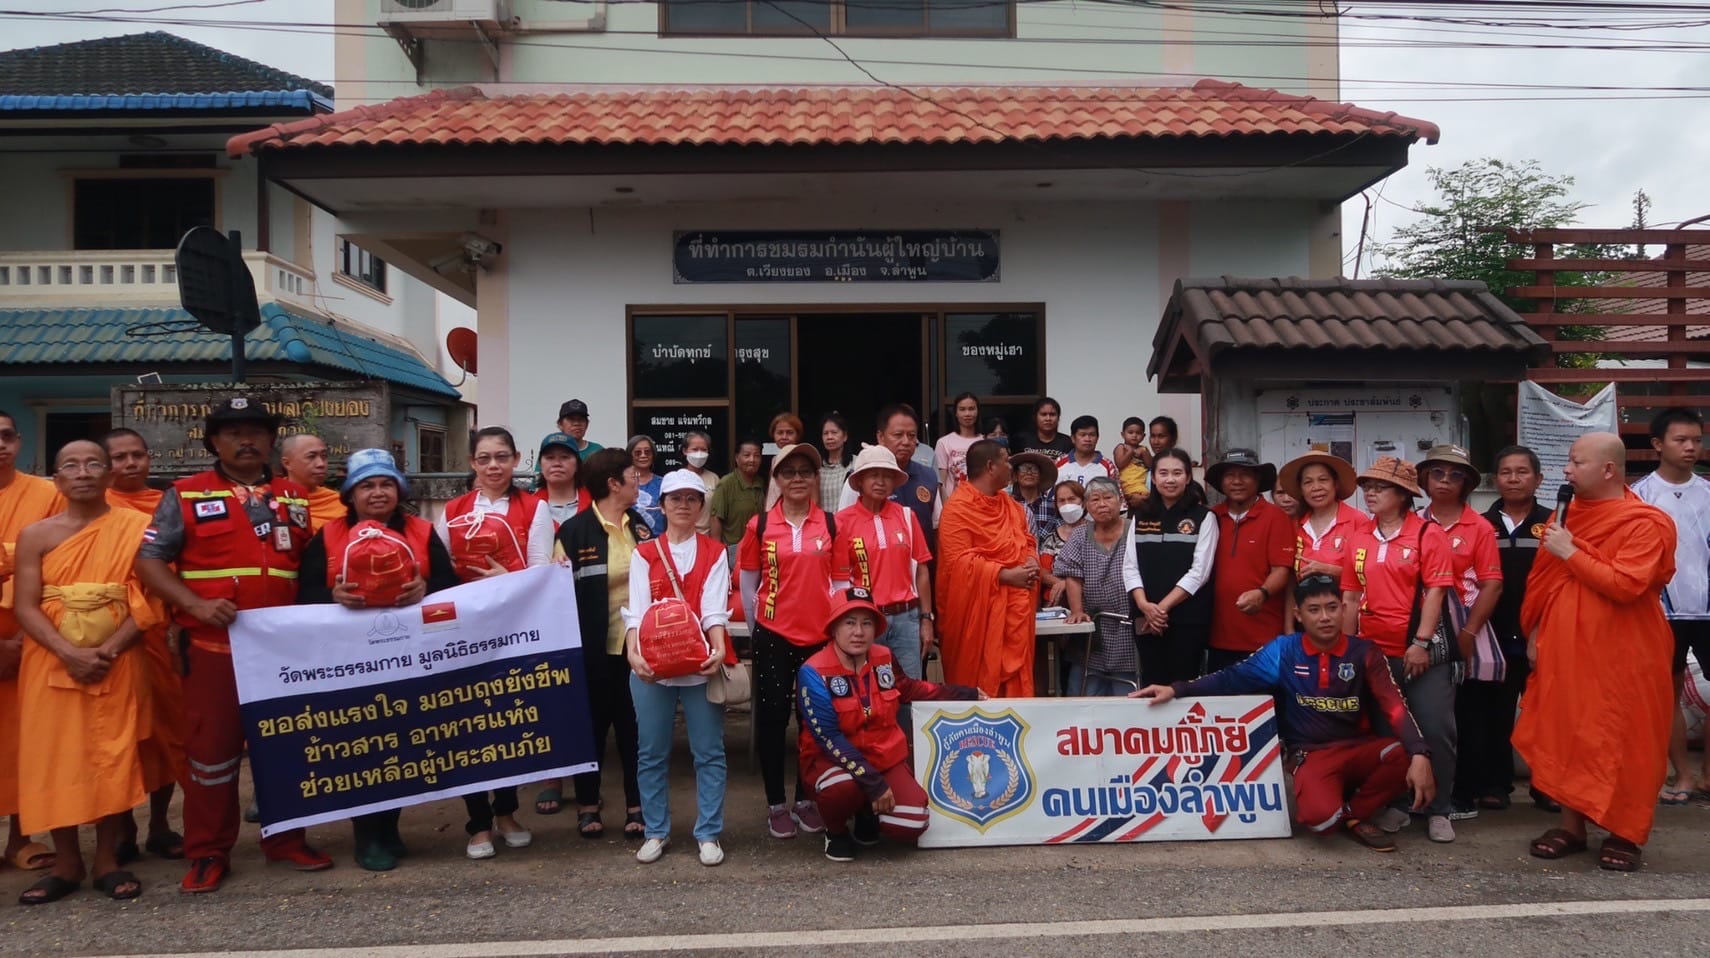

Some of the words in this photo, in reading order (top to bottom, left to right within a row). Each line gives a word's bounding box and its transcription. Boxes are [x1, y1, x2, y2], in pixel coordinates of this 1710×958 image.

[688, 233, 985, 264] ที่ทำการชมรมกำนันผู้ใหญ่บ้าน
[746, 263, 812, 277] ต.เวียงยอง
[824, 263, 867, 277] อ.เมือง
[879, 262, 928, 279] จ.ลำพูน
[652, 344, 712, 364] บำบัดทุกข์
[962, 343, 1023, 360] ของหมู่เฮา
[764, 541, 779, 621] RESCUE
[279, 653, 412, 685] วัดพระธรรมกาย
[418, 627, 541, 670] มูลนิธิธรรมกาย
[258, 693, 408, 738] ขอส่งแรงใจ
[419, 661, 571, 712] มอบถุงยังชีพ
[304, 733, 399, 764] ข้าวสาร
[409, 698, 540, 746] อาหารแห้ง
[1056, 712, 1249, 764] สมาคมกู้ภัย
[300, 732, 552, 799] ช่วยเหลือผู้ประสบภัย
[1042, 771, 1283, 823] คนเมืองลำพูน
